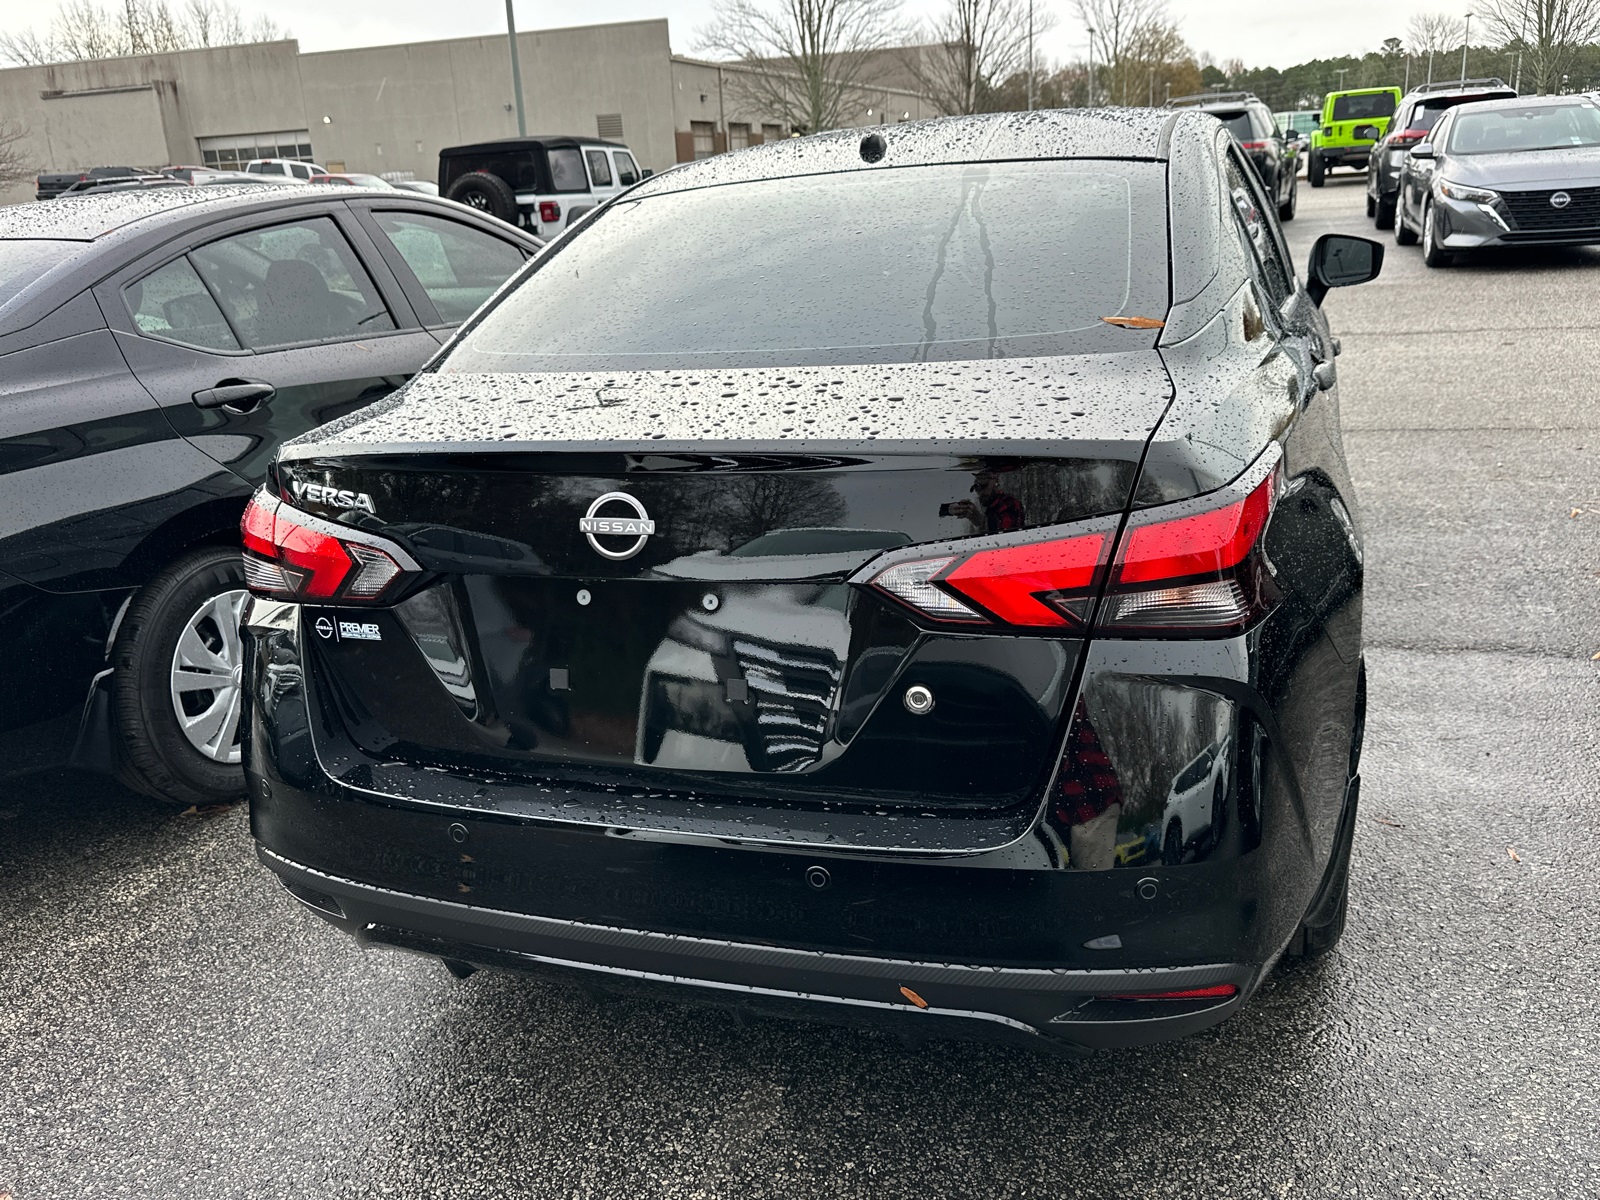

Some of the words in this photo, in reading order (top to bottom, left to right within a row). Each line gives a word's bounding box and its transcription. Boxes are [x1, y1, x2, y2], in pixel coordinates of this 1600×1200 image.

[292, 481, 376, 513] VERSA
[581, 520, 652, 533] NISSAN
[339, 621, 381, 635] PREMIER
